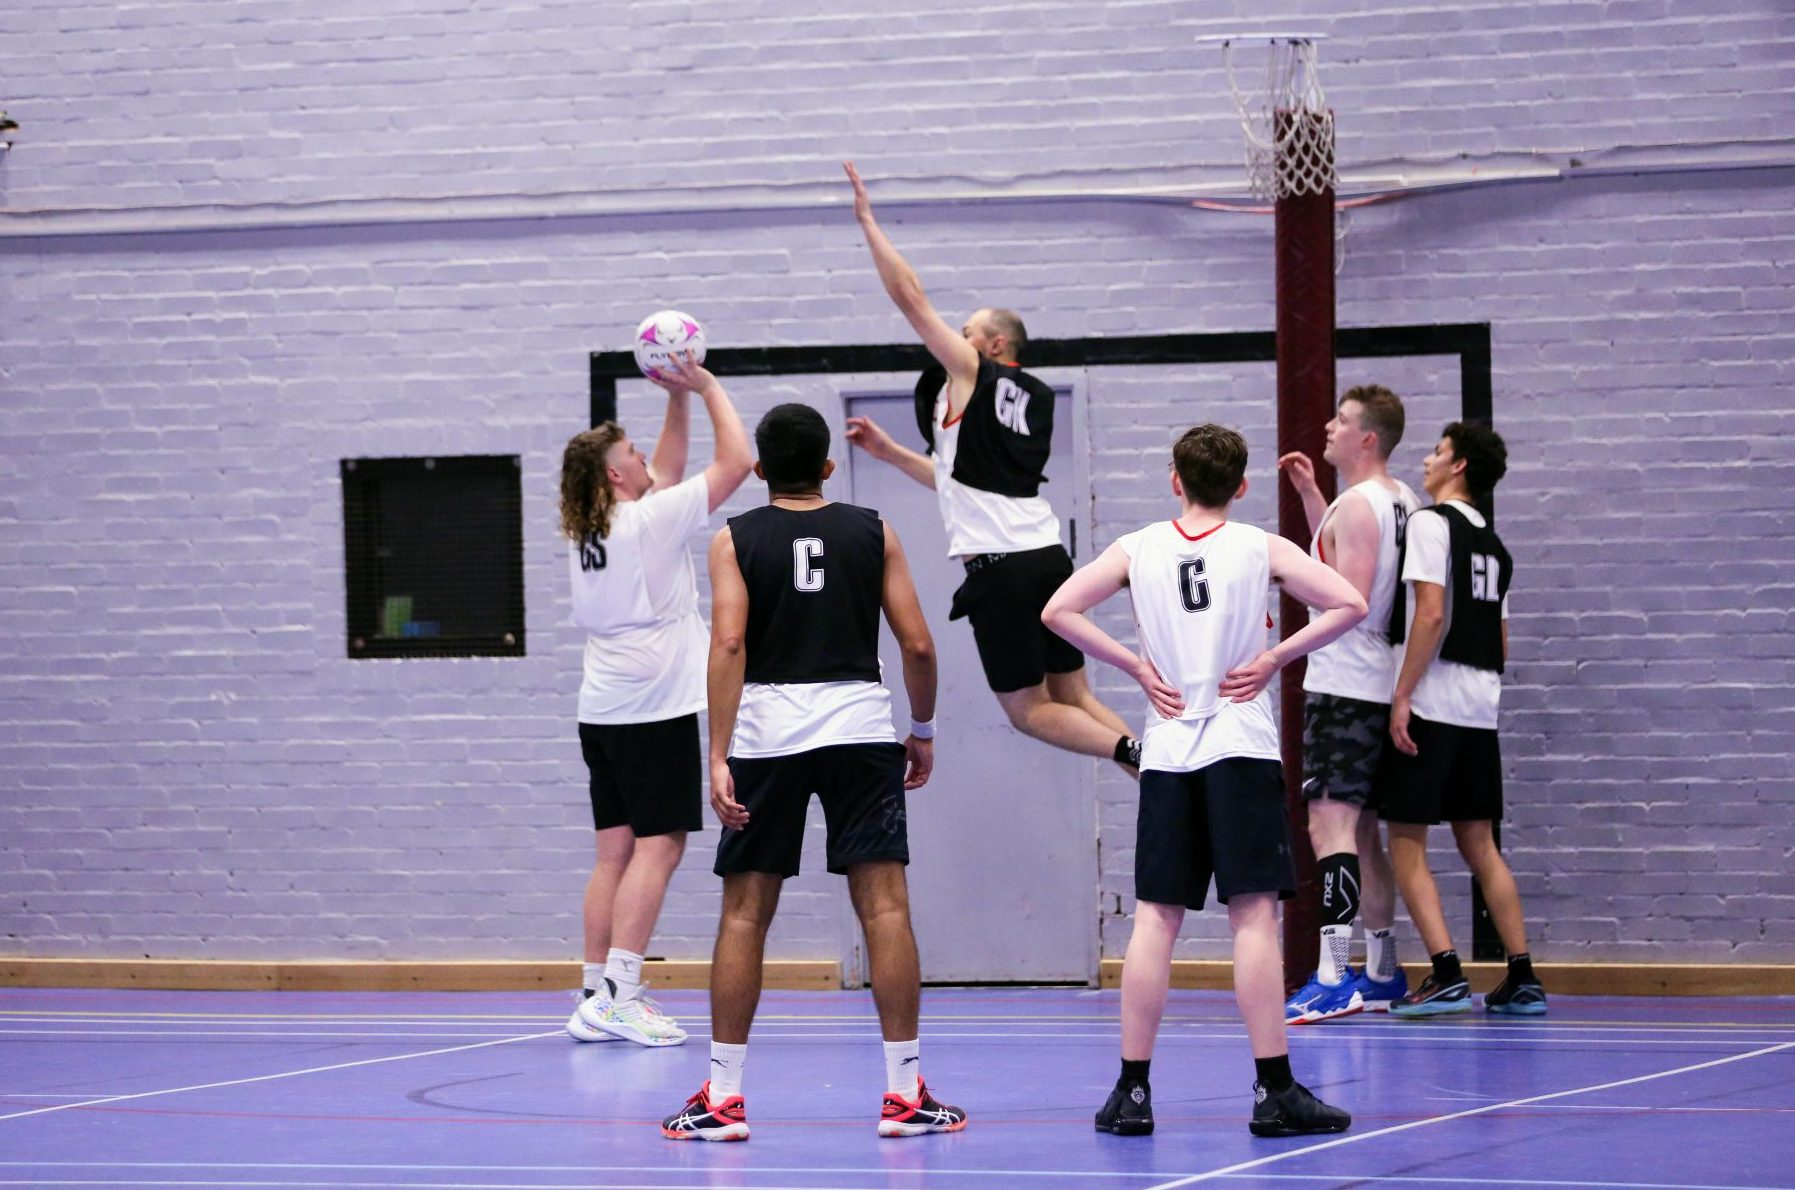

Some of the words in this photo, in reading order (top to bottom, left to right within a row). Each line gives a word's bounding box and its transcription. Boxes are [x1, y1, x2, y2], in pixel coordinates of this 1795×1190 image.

[995, 377, 1031, 436] GK
[793, 537, 825, 592] C
[1177, 557, 1212, 613] C
[1323, 871, 1334, 907] 2XU
